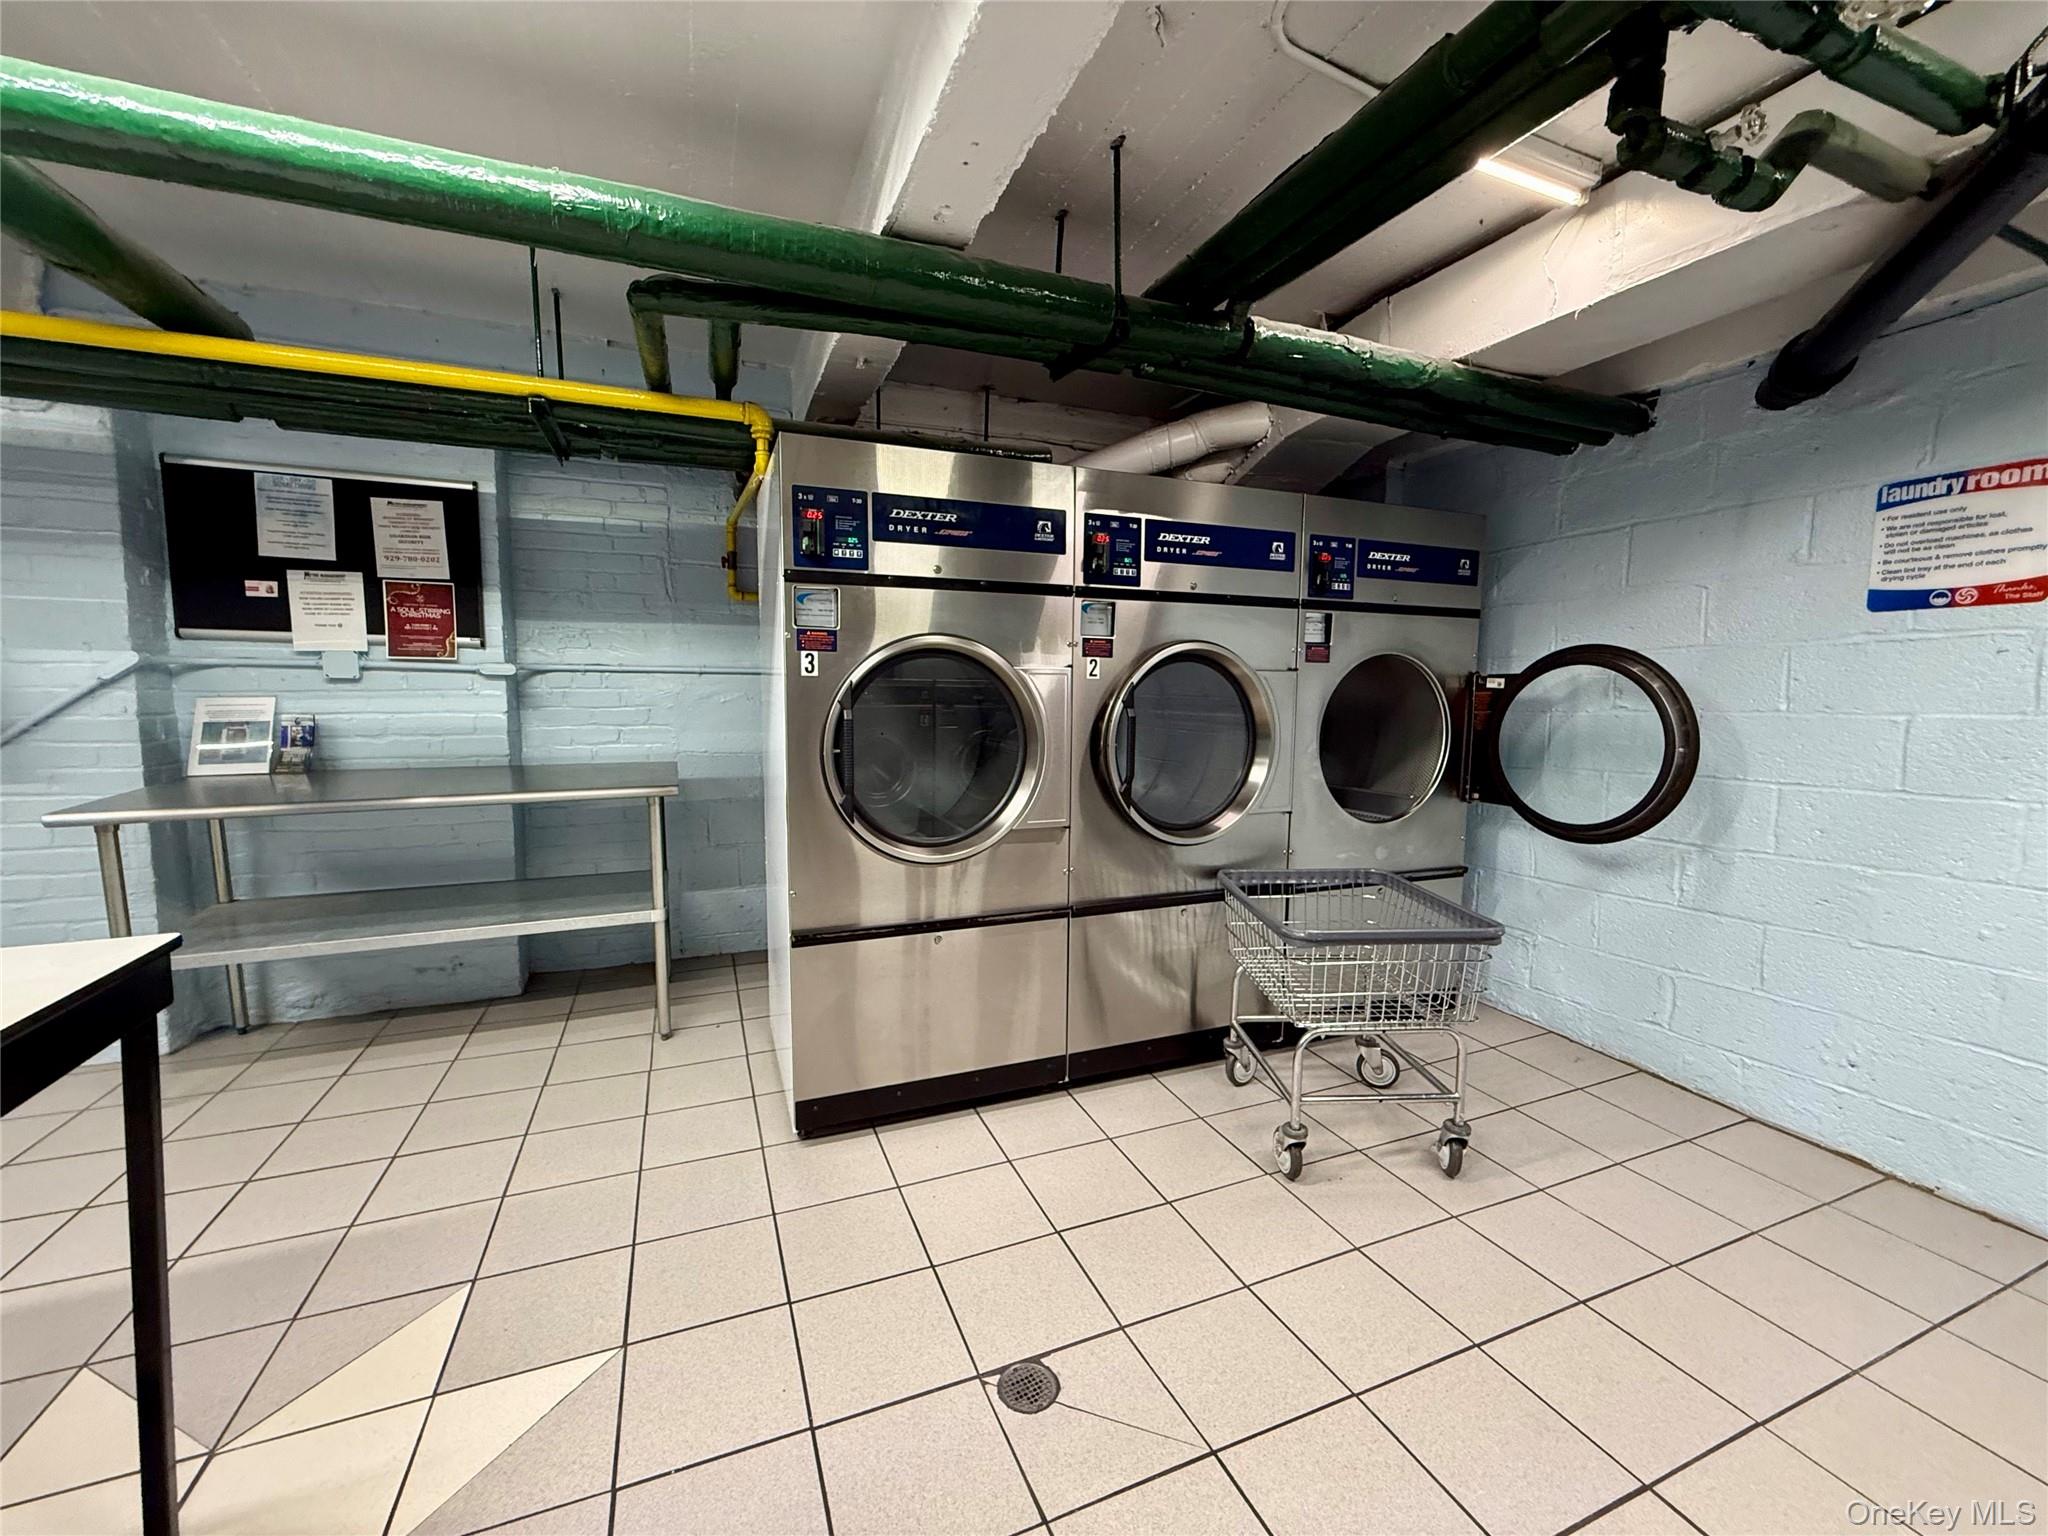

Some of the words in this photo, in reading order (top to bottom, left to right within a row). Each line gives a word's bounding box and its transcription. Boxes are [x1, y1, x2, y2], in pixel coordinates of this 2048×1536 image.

[1881, 476, 1964, 503] laundry
[1967, 463, 2048, 490] room
[890, 509, 958, 522] DEXTER
[1901, 510, 1931, 519] resident
[1927, 515, 1973, 526] responsible
[889, 525, 927, 534] DRYER
[1886, 530, 1908, 538] stolen
[1920, 525, 1956, 535] damaged
[1158, 533, 1211, 544] DEXTER
[1911, 537, 1943, 545] overload
[2001, 527, 2033, 535] clothes
[1157, 546, 1187, 554] DRYER
[1894, 556, 1932, 564] courteous
[1975, 548, 2005, 556] clothes
[2008, 544, 2048, 553] promptly
[1368, 552, 1410, 562] DEXTER
[1906, 573, 1926, 581] cycle
[805, 653, 815, 673] 3
[1089, 659, 1097, 677] 2
